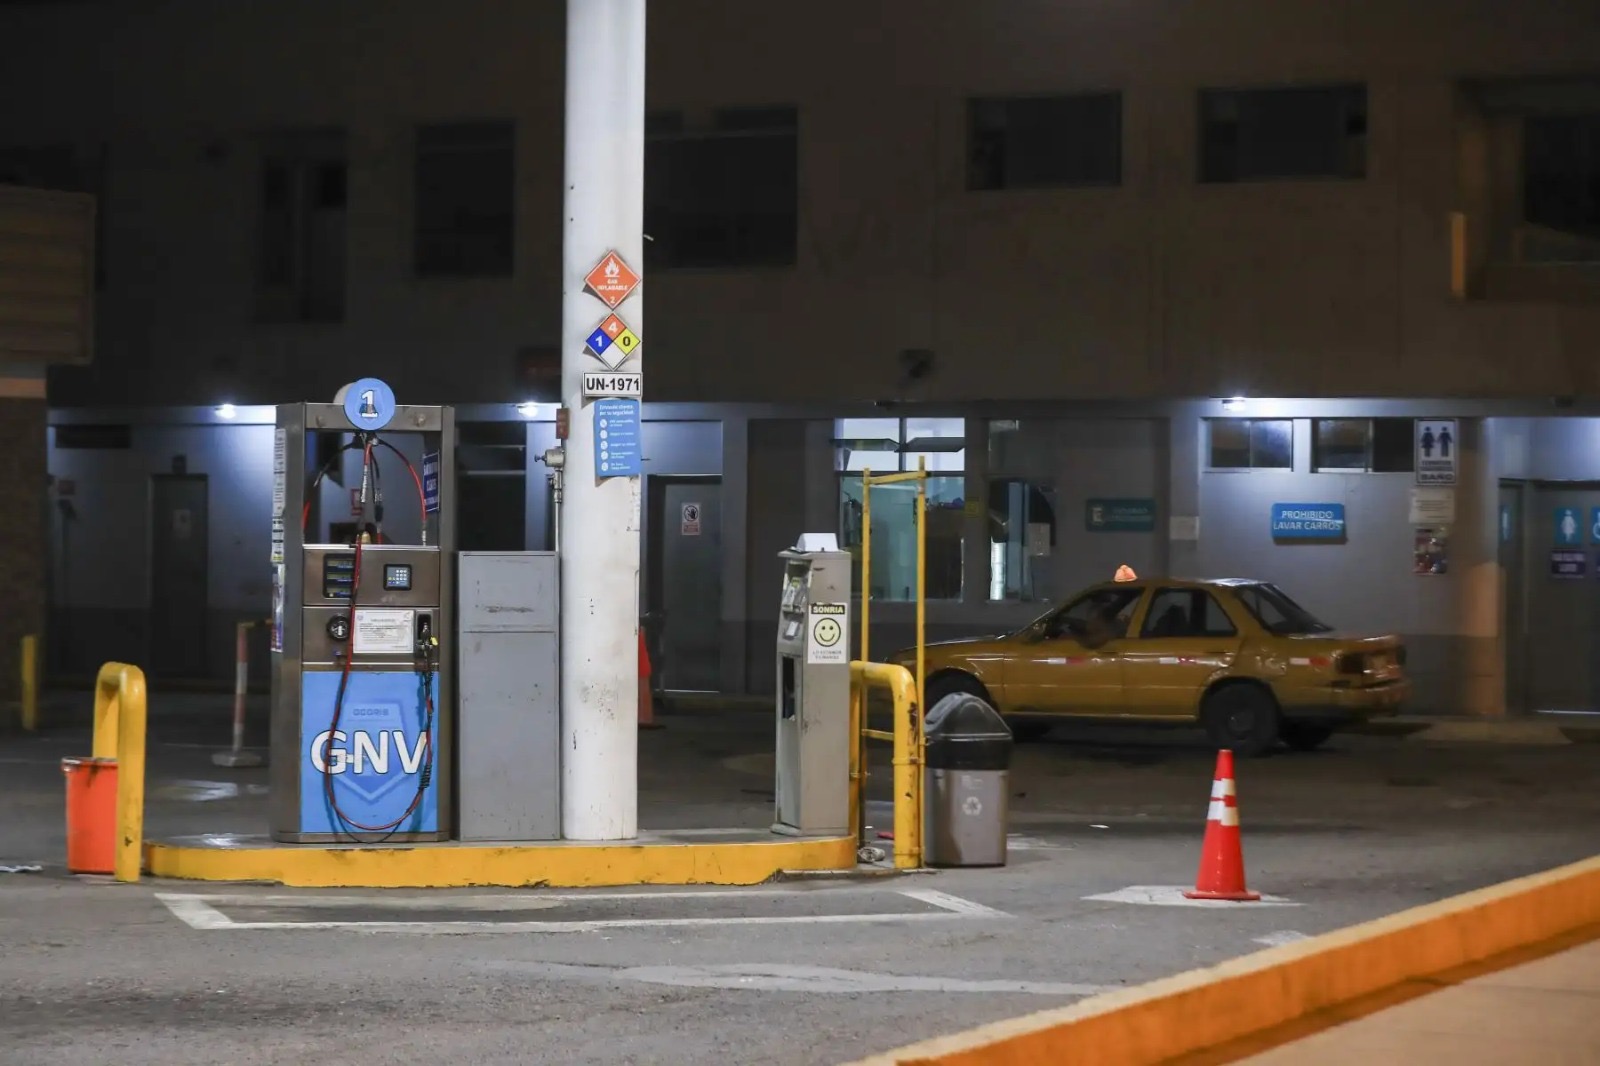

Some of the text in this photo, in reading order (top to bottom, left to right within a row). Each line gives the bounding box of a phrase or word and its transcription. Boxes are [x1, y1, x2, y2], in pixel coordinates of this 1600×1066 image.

[610, 296, 616, 304] 2
[608, 321, 618, 333] 4
[595, 336, 603, 347] 1
[622, 336, 631, 347] 0
[586, 378, 639, 391] UN-1971
[361, 390, 379, 418] 1
[1281, 510, 1334, 519] PROHIBIDO
[1273, 521, 1341, 530] LAVAR CARROS
[813, 606, 844, 614] SONRIA
[311, 730, 428, 775] GNV
